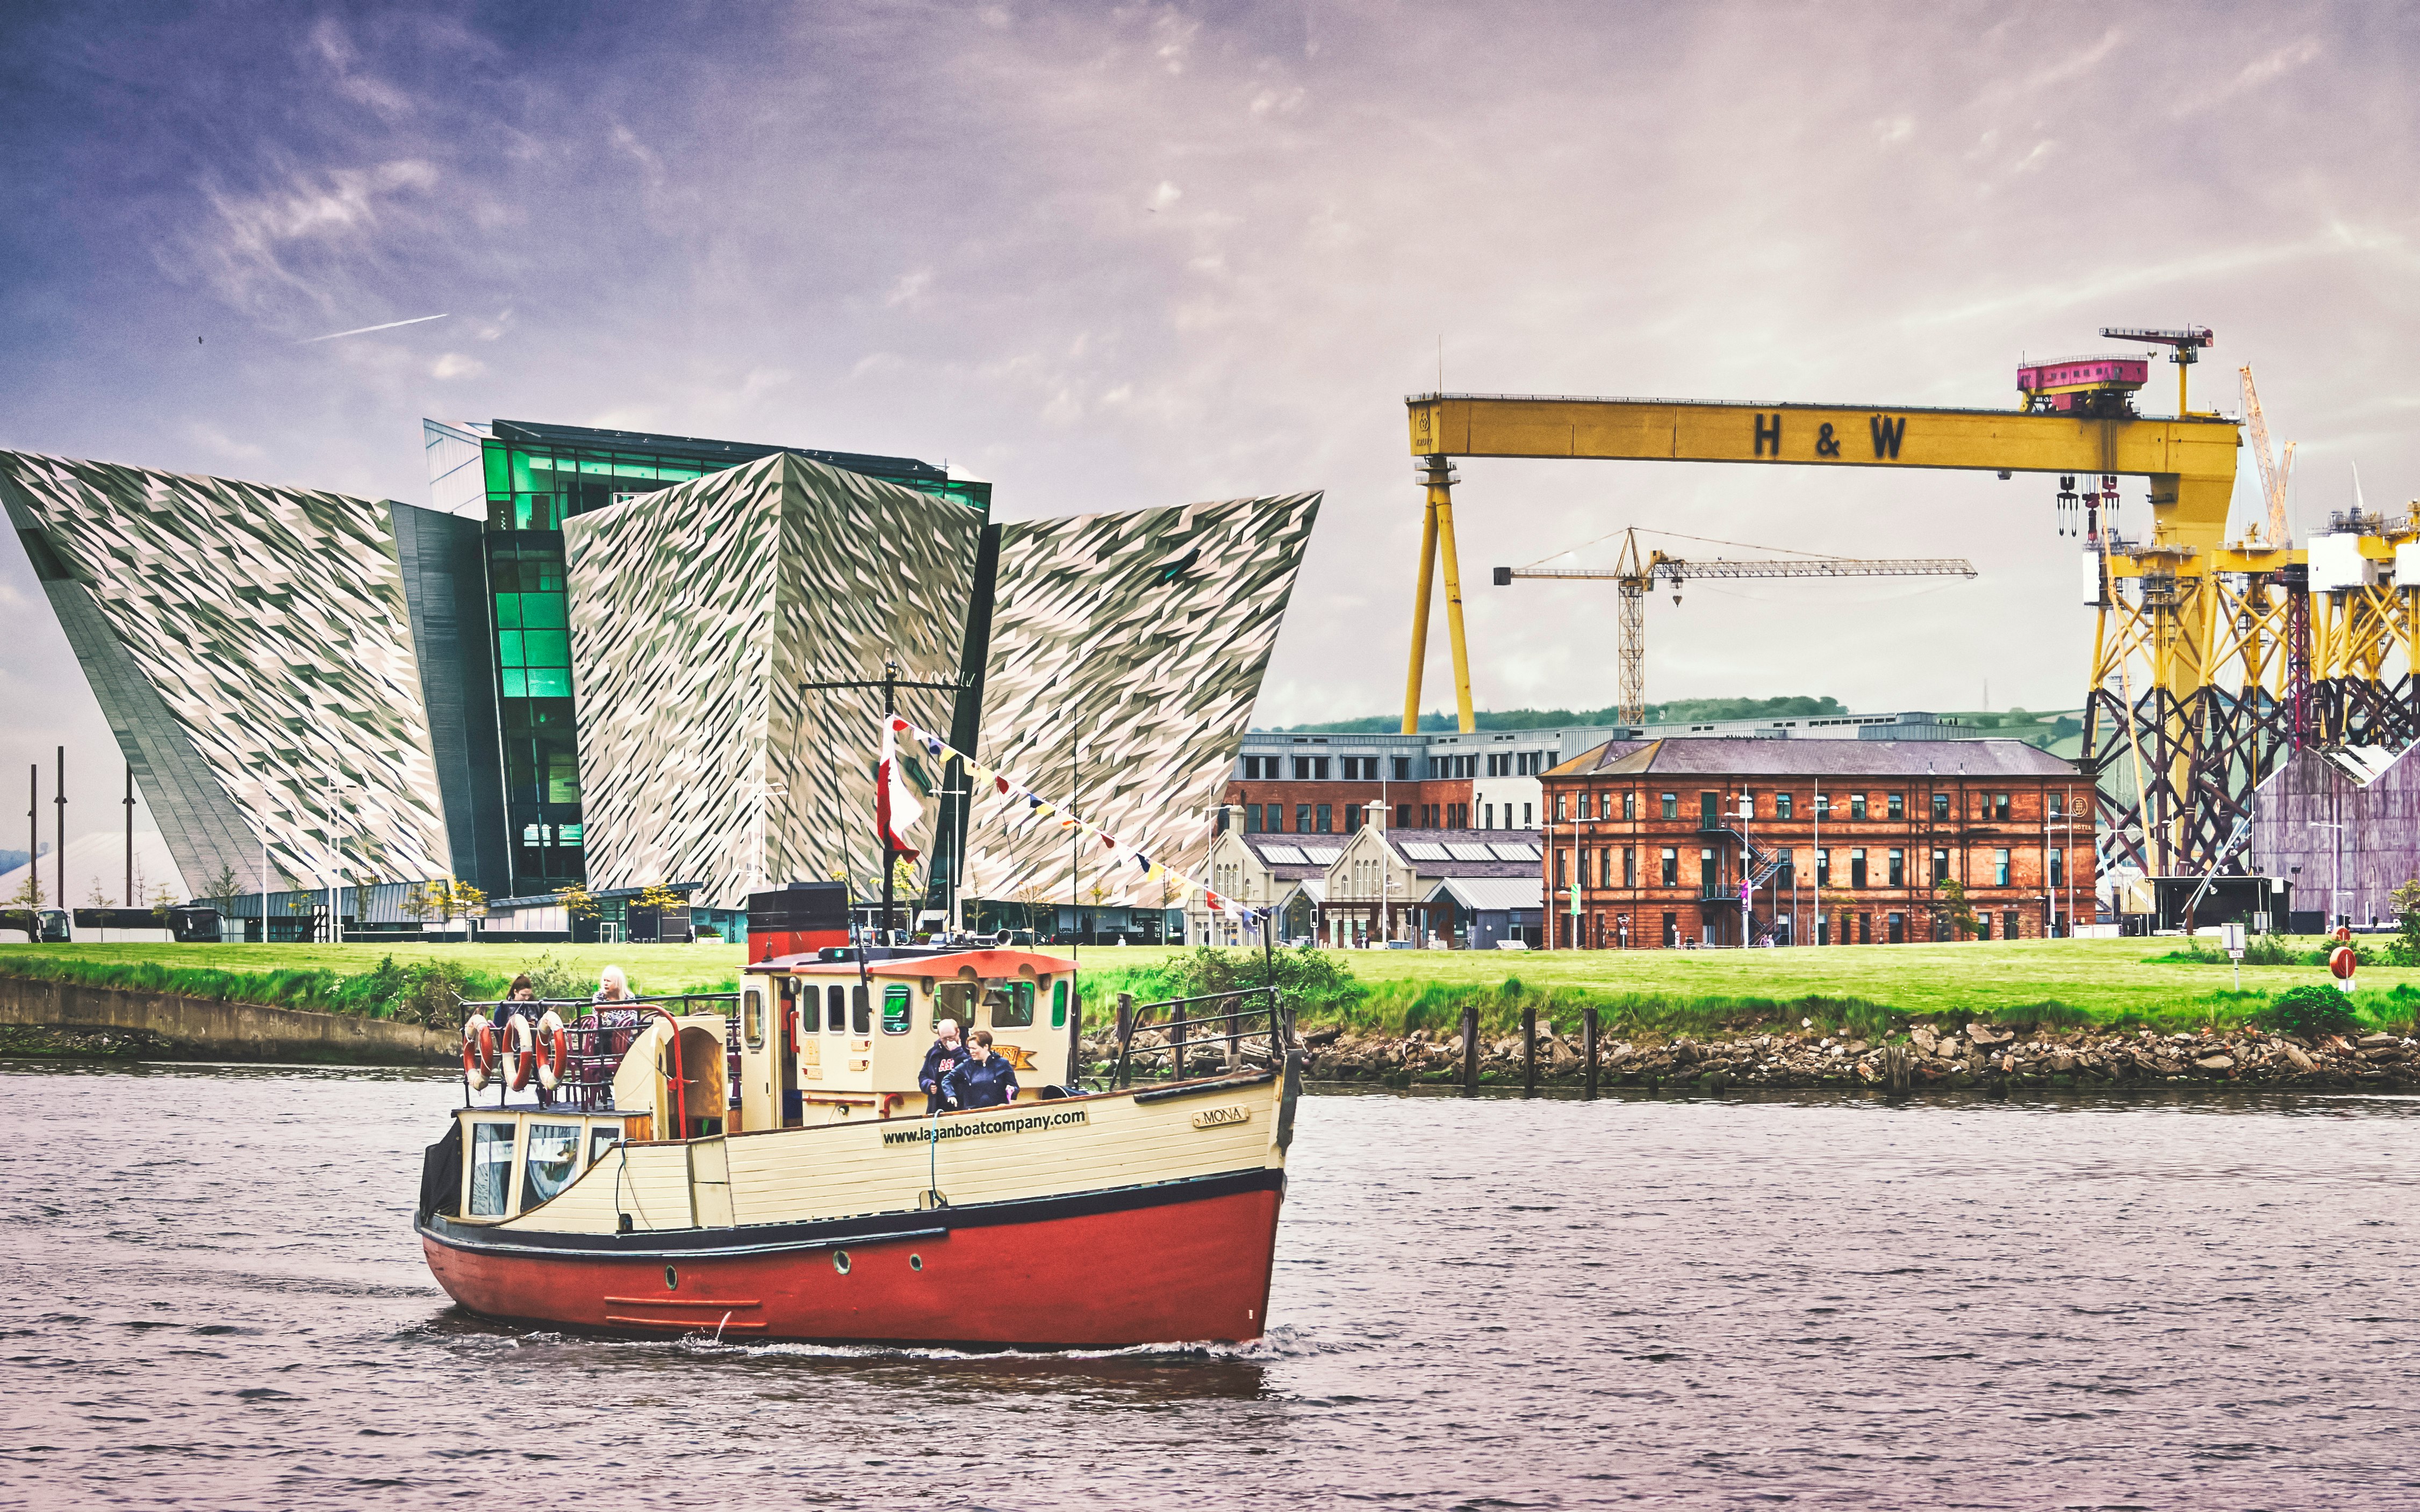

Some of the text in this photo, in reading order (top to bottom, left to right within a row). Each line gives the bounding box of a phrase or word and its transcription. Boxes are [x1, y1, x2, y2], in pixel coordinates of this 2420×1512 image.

[1755, 414, 1906, 458] H & W
[884, 1110, 1085, 1144] www.laganboatcompany.com
[1203, 1107, 1242, 1125] MONA
